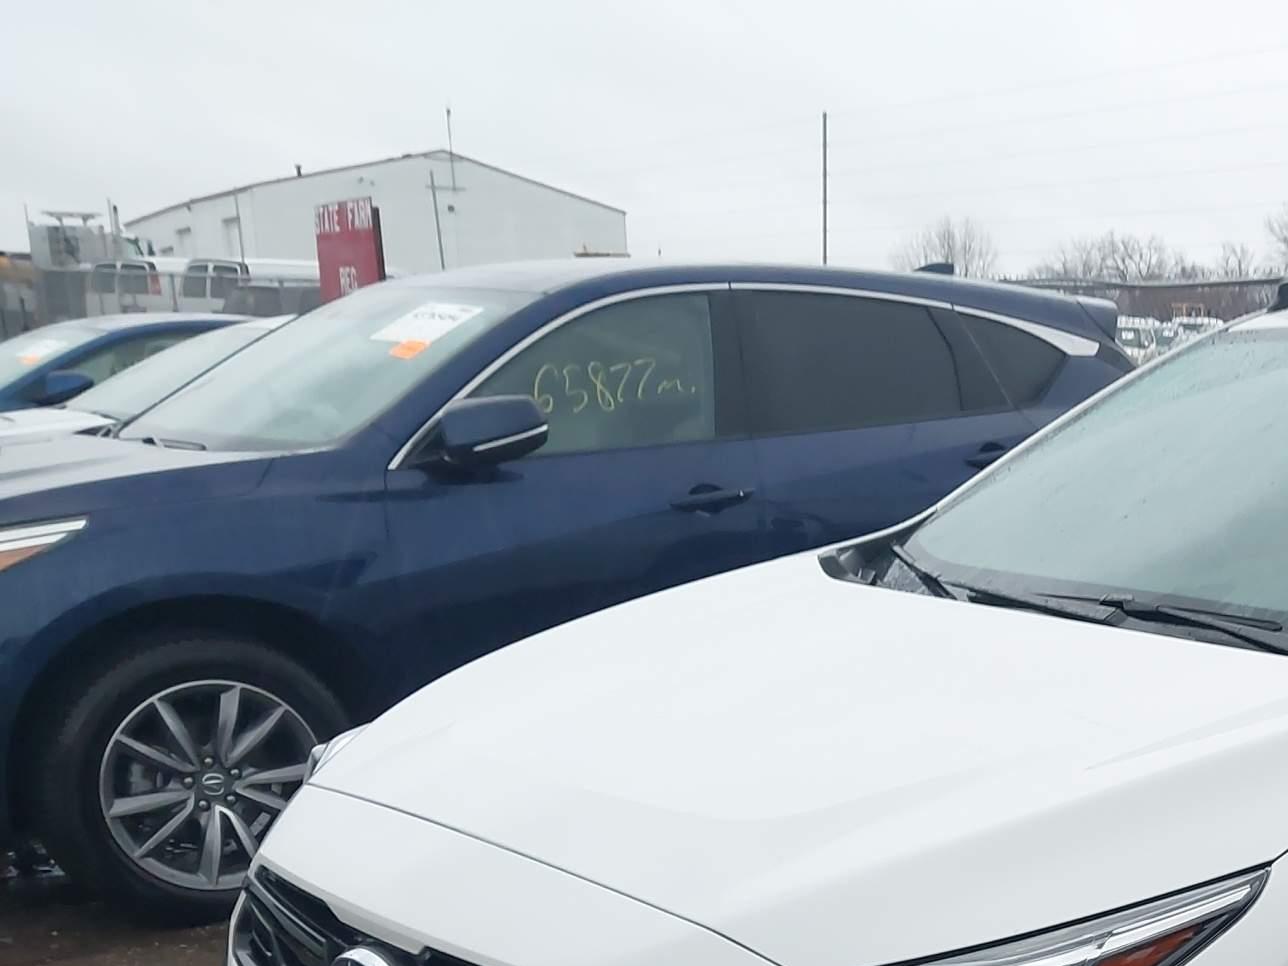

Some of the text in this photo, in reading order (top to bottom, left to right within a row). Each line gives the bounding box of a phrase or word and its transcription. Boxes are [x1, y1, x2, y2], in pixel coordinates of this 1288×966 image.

[314, 199, 373, 234] STATE FARM
[534, 358, 656, 413] 65877
